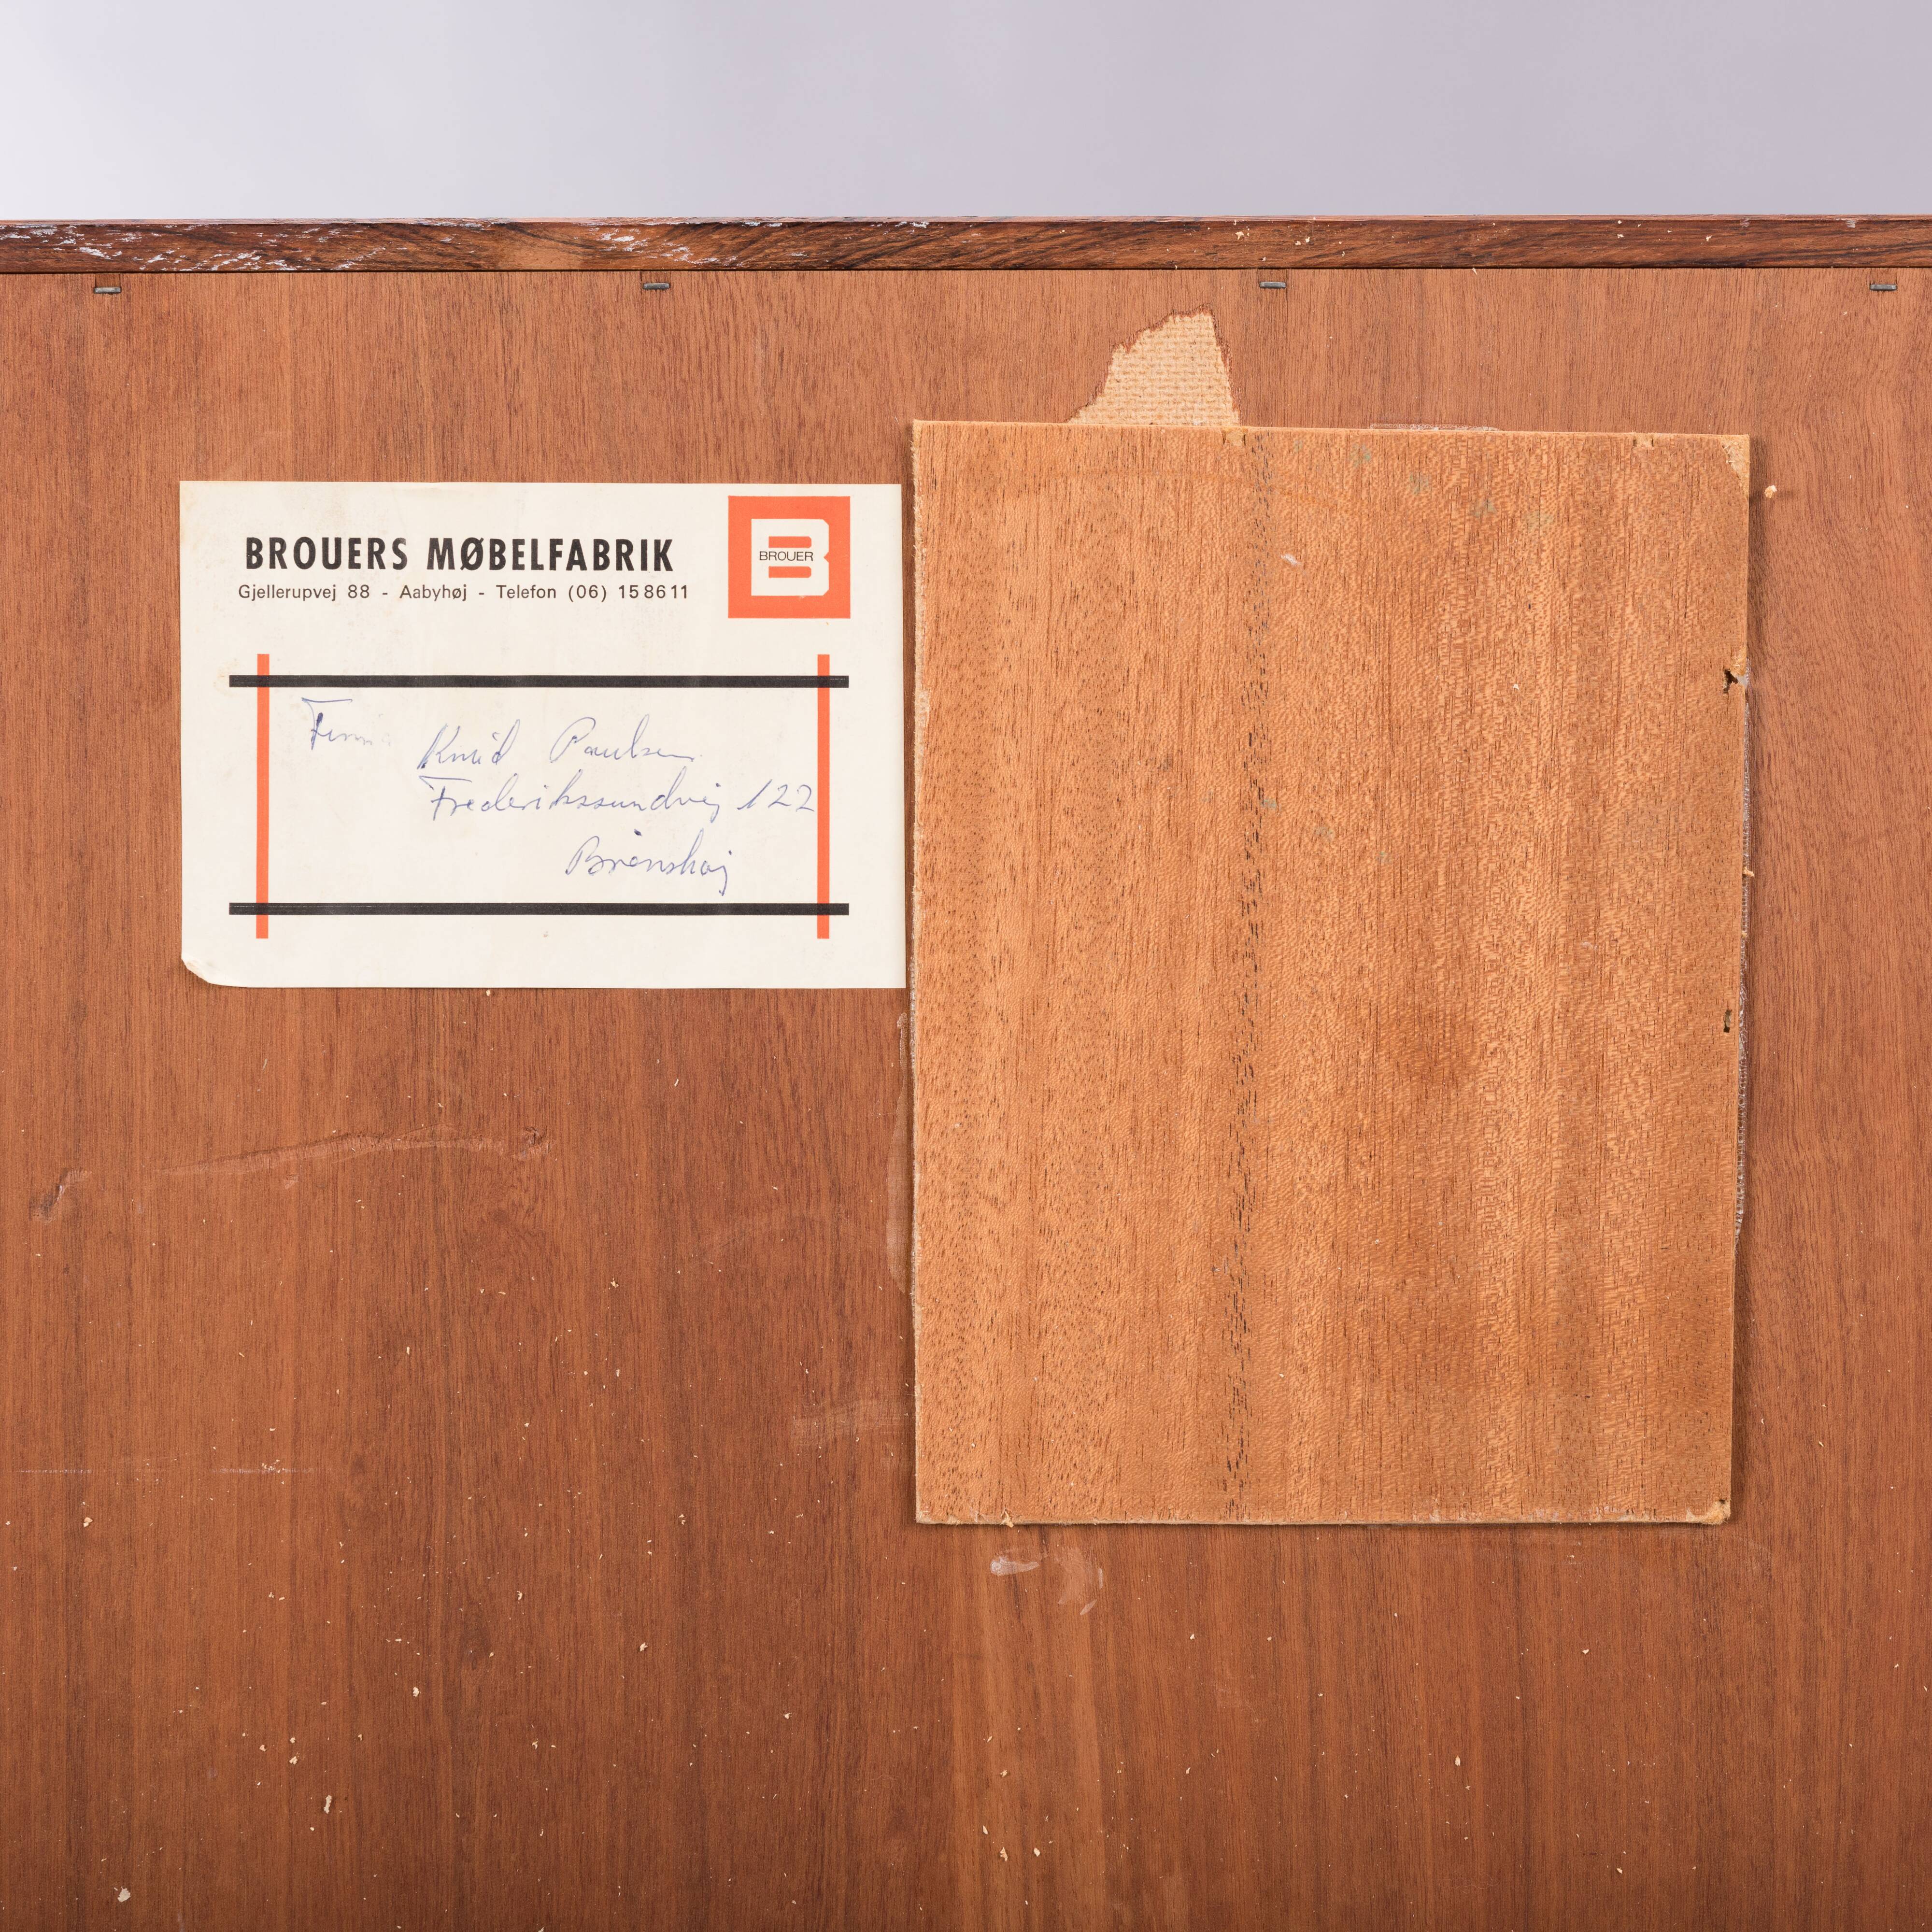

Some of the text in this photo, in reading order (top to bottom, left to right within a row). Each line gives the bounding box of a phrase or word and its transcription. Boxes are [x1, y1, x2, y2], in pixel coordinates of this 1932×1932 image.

[246, 537, 673, 571] BROUERS MØBELFABRIK
[759, 551, 813, 561] BROUER
[239, 584, 336, 602] Gjellerupvej
[348, 584, 369, 598] 88
[399, 584, 467, 601] Aabyhøj
[496, 584, 556, 599] Telefon
[568, 584, 607, 603] (06)
[737, 779, 815, 812] 122
